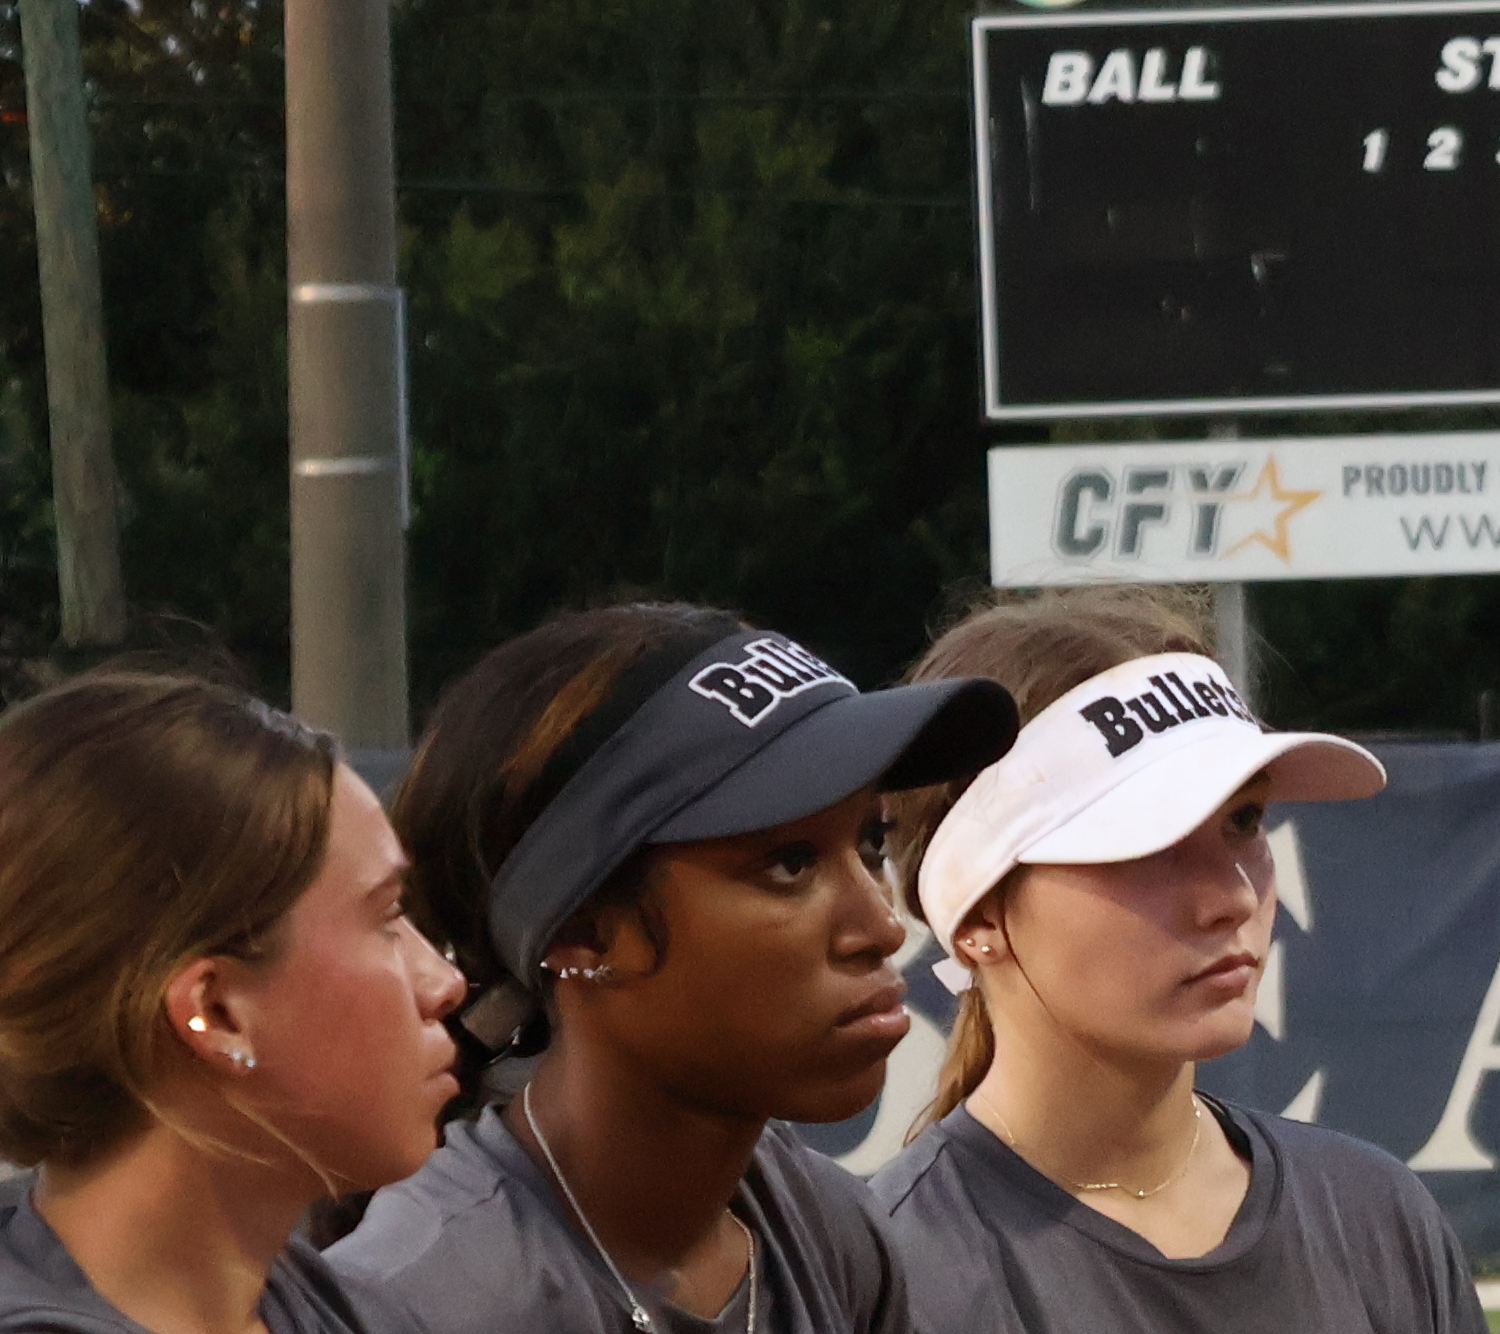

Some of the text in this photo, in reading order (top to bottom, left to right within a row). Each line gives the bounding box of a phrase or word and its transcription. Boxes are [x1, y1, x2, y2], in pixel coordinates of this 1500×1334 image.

[1042, 47, 1221, 106] BALL
[1362, 128, 1387, 172] 1
[1424, 126, 1463, 170] 2
[1342, 460, 1487, 497] PROUDLY
[1050, 460, 1248, 562] CFY
